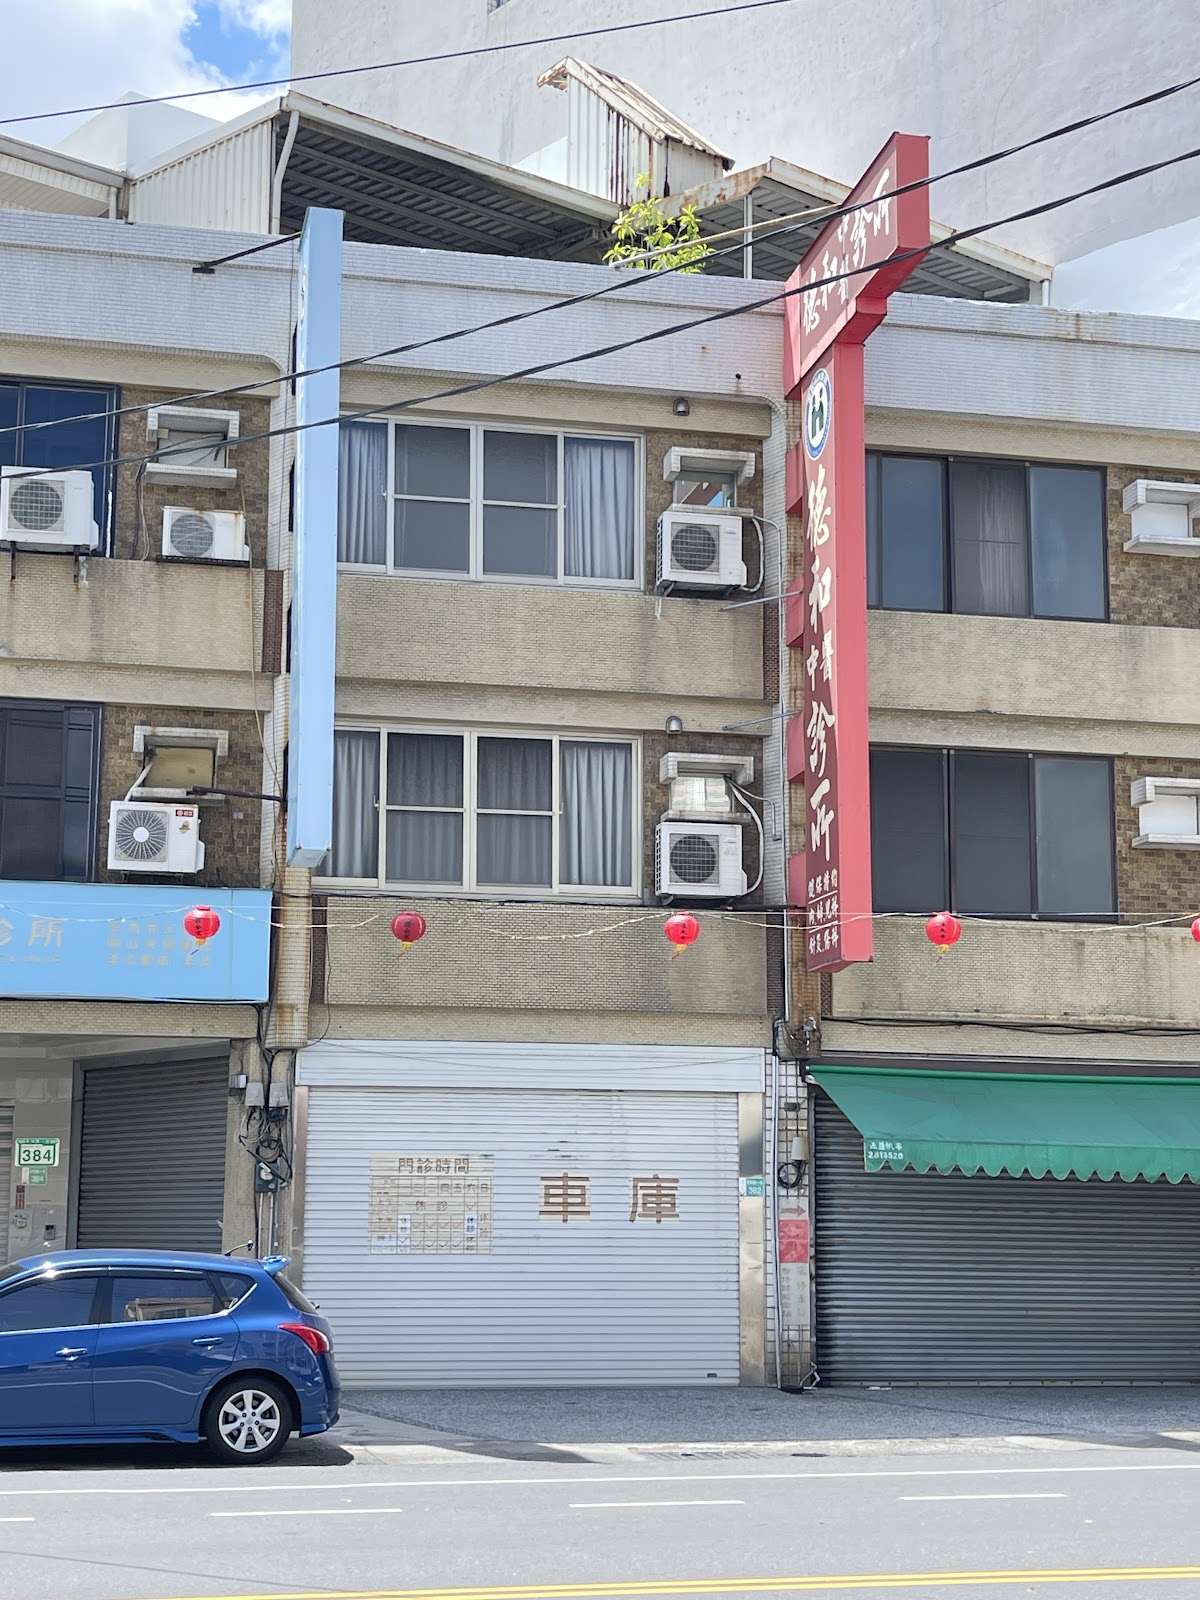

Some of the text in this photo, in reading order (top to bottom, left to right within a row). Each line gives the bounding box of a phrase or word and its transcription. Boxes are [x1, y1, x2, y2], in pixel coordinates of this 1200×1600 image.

[22, 1149, 52, 1162] 384
[399, 1158, 470, 1174] 門診時間
[539, 1172, 680, 1223] 車庫
[748, 1186, 762, 1195] 382
